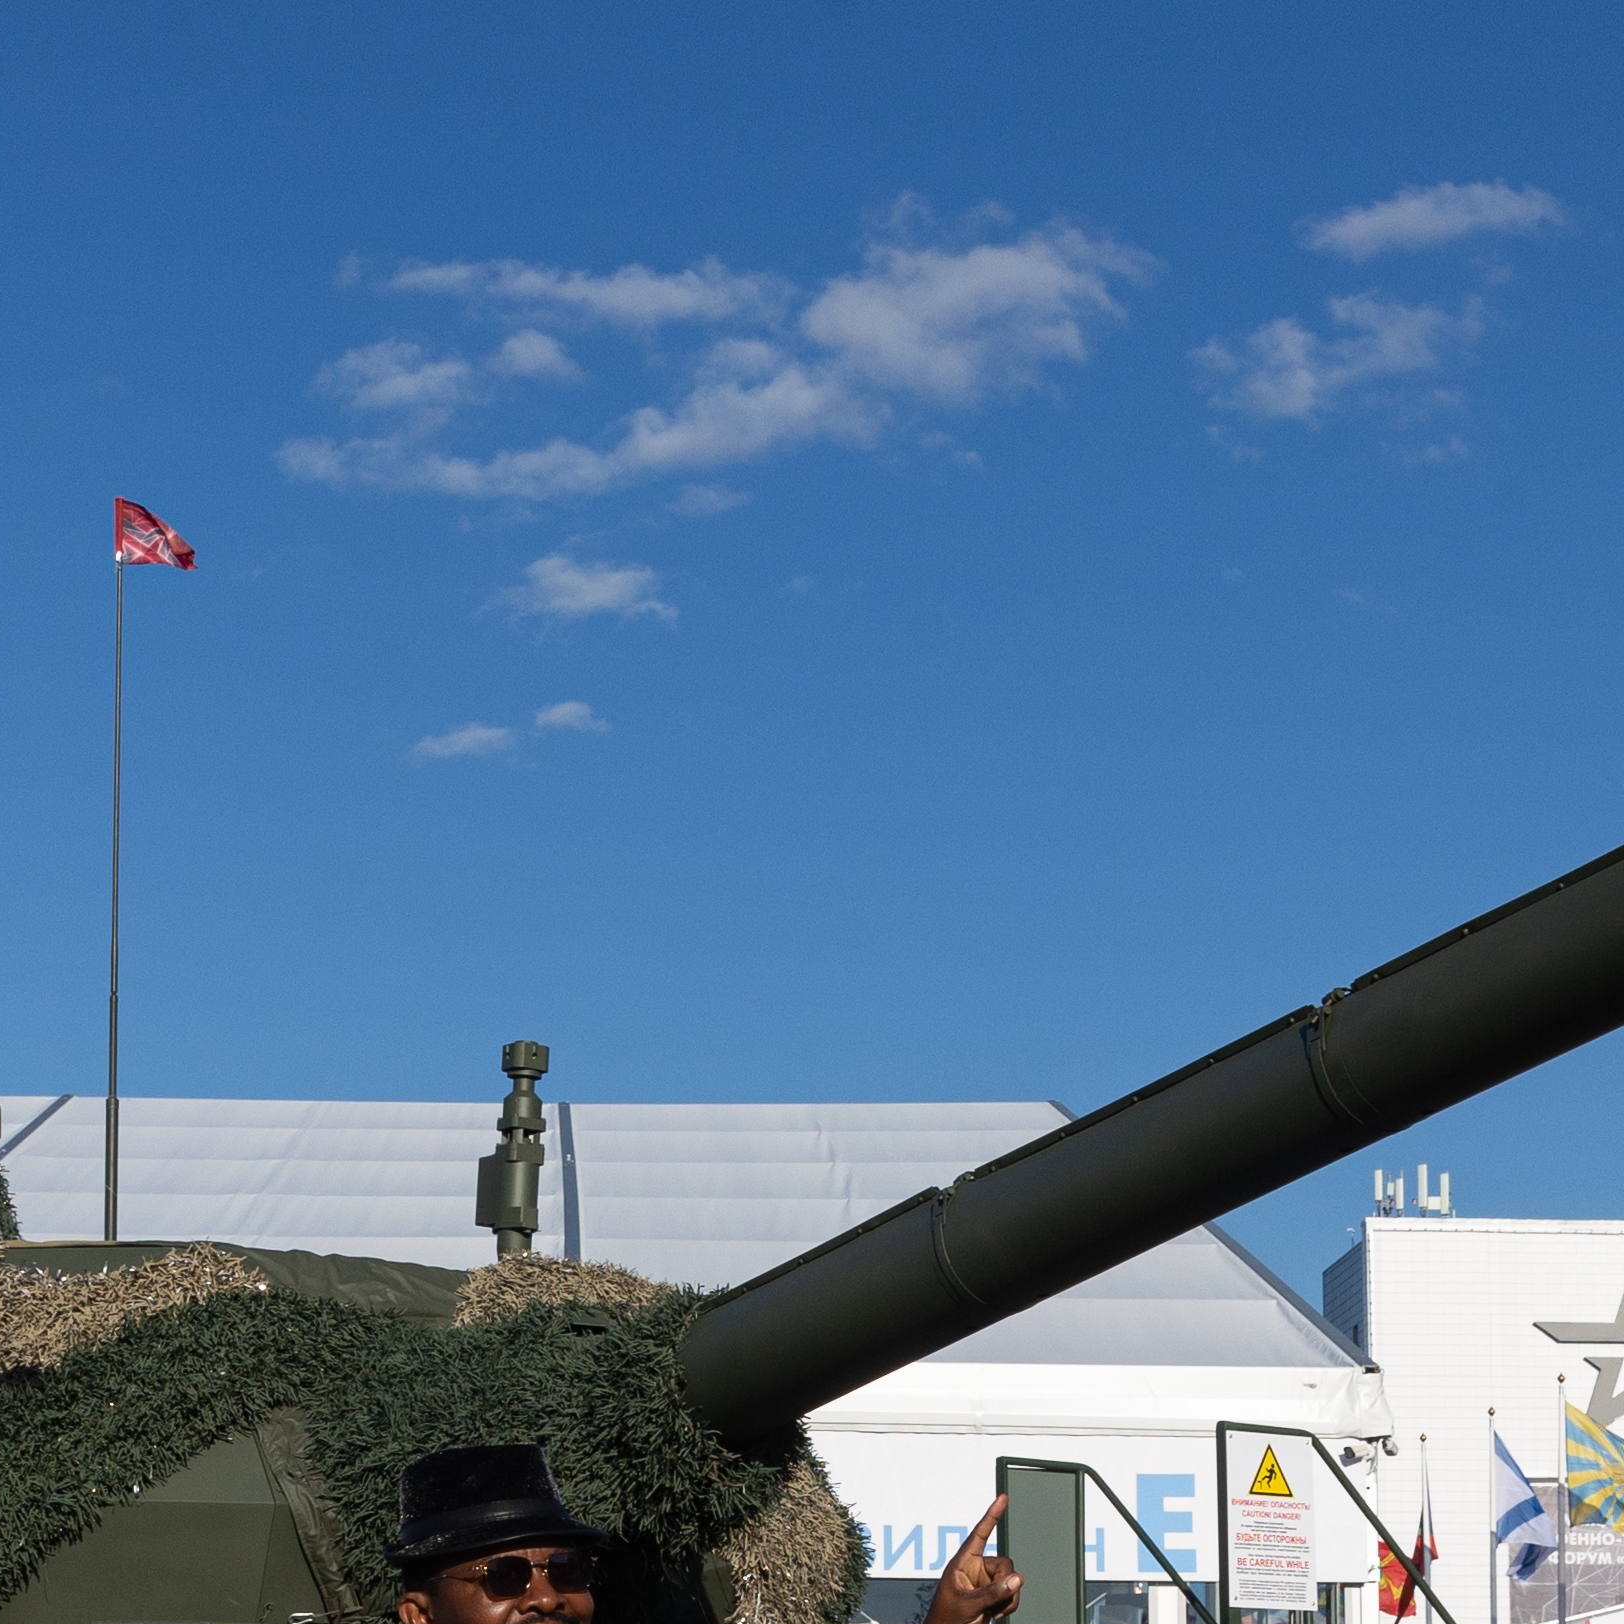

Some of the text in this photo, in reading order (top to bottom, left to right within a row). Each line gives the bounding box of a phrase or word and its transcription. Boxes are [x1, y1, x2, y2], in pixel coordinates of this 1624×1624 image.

[1237, 1557, 1309, 1569] BE CAREFUL WHILE
